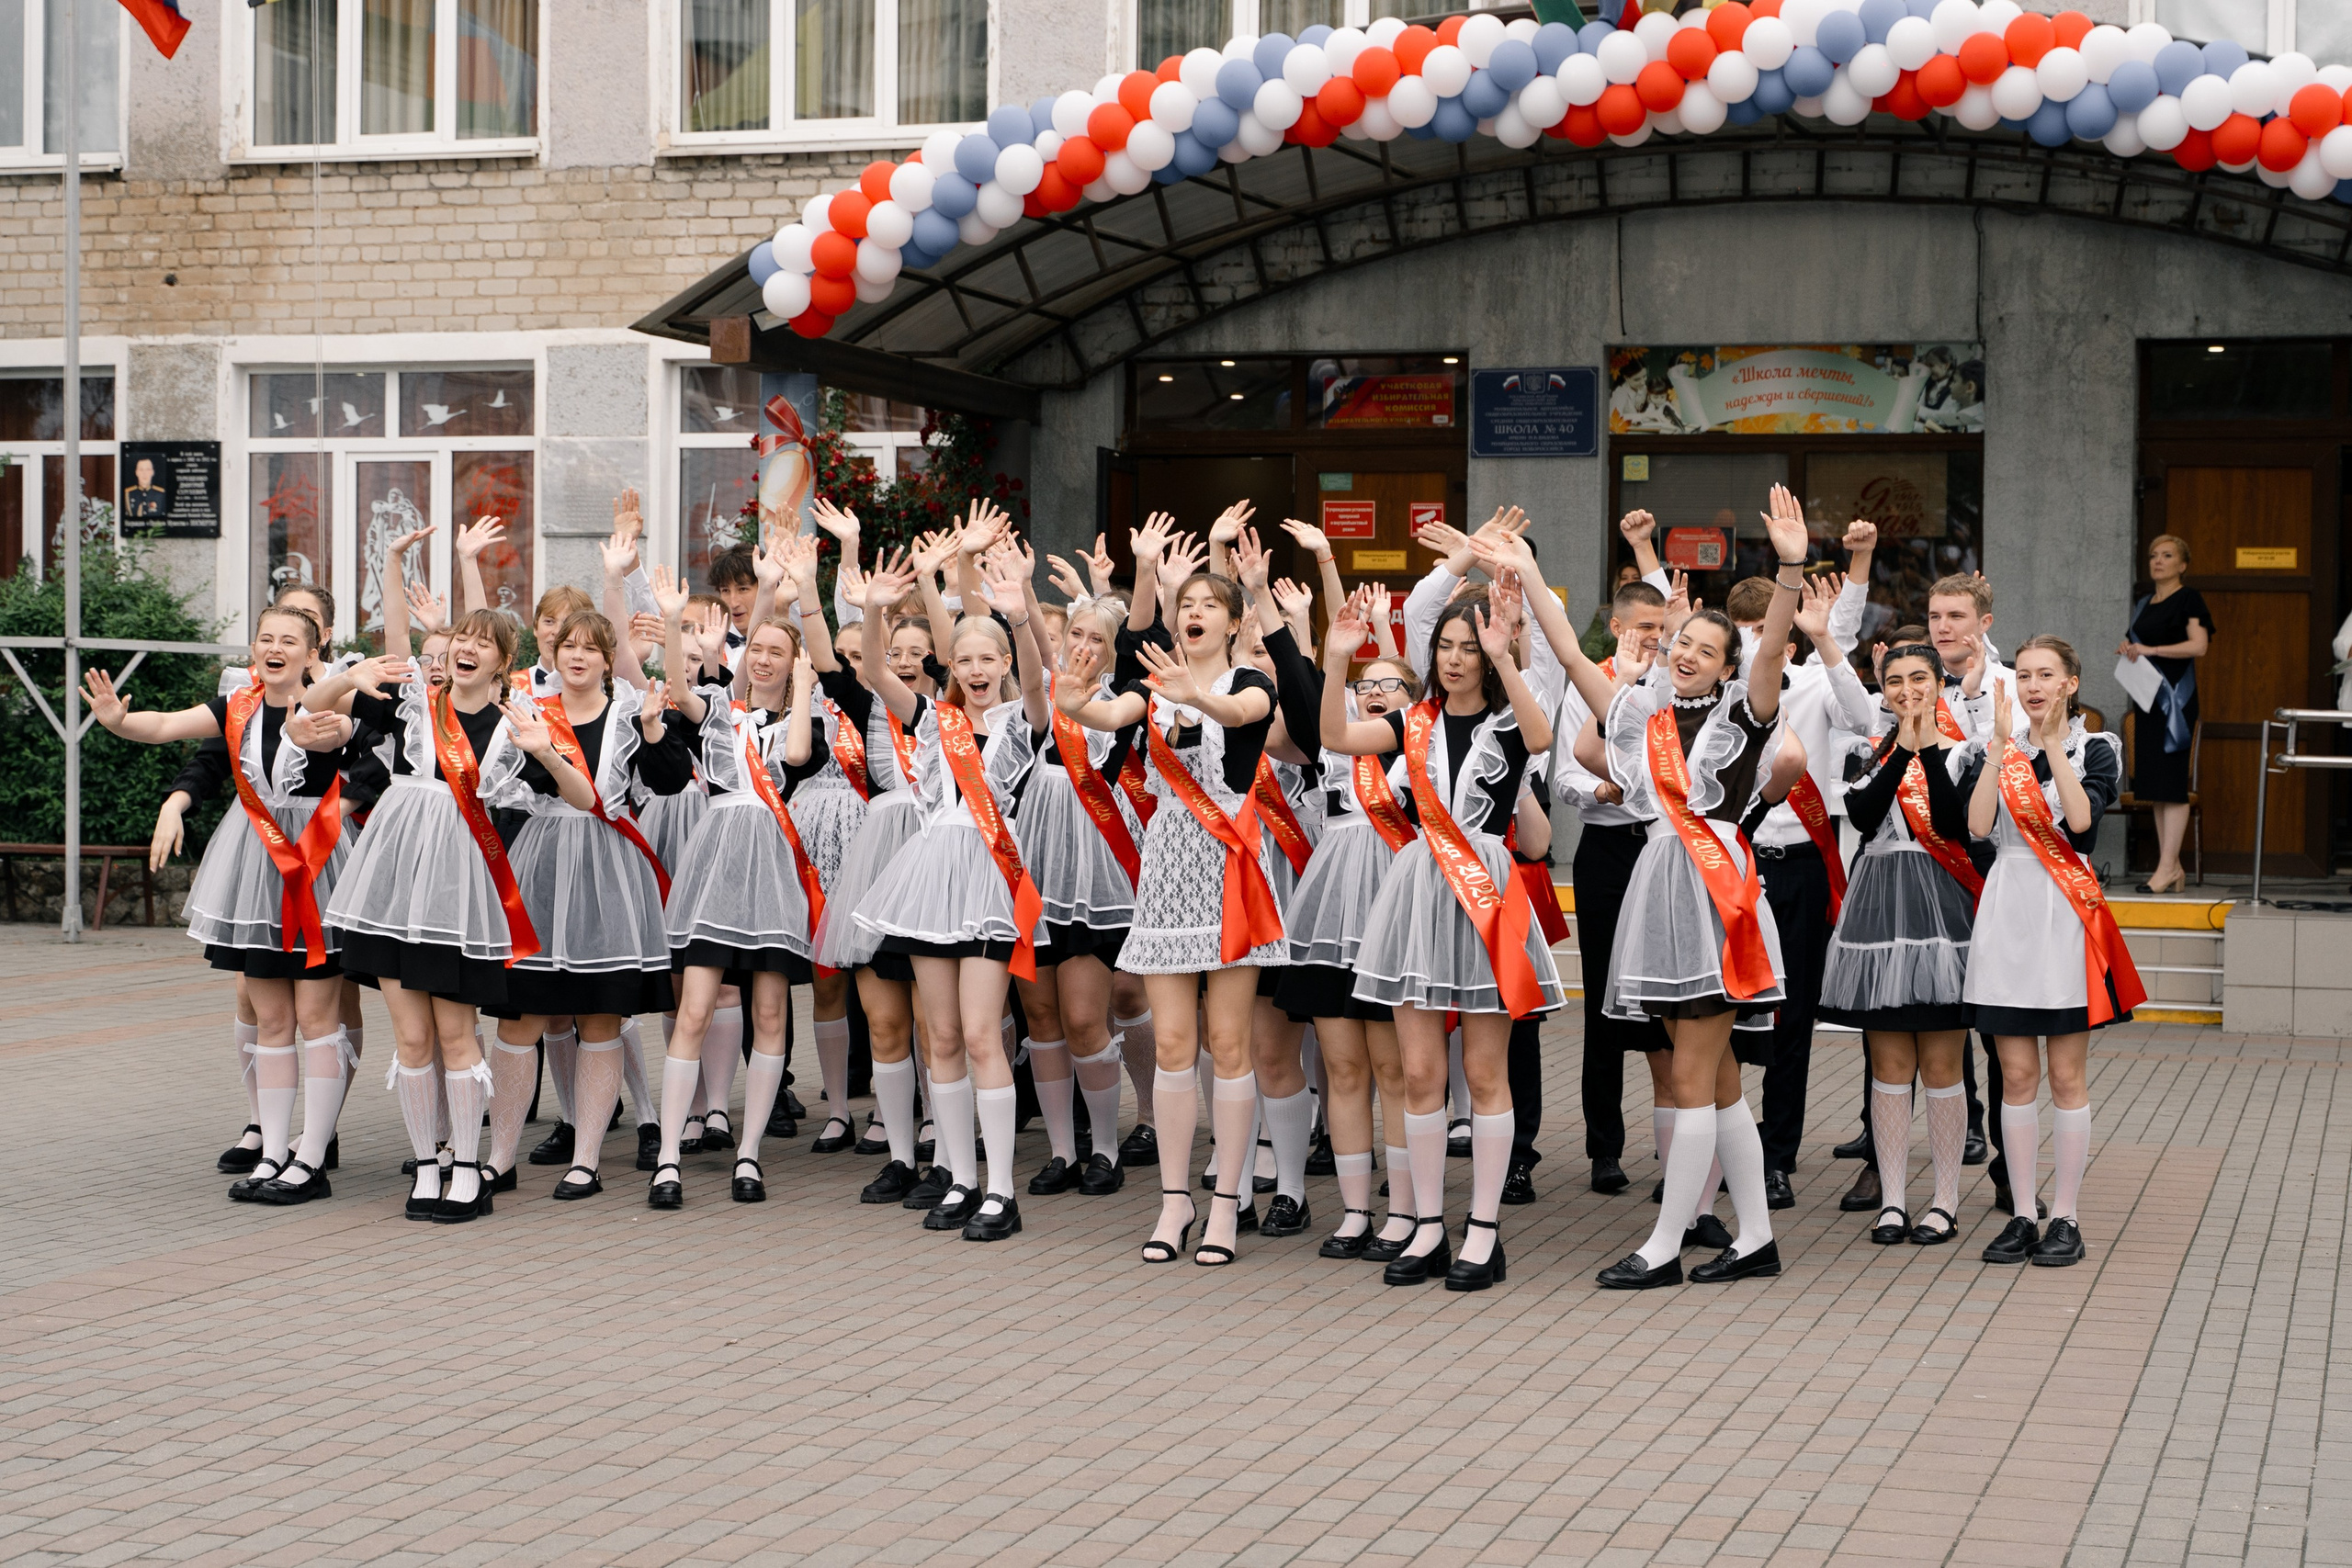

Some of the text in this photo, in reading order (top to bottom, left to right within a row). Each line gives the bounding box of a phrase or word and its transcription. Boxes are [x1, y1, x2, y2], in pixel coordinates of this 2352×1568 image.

[1380, 382, 1442, 390] УЧАСТКОВАЯ
[1732, 366, 1856, 386] «Школа мечты,
[1373, 393, 1449, 401] ИЗБИРАТЕЛЬНАЯ
[1725, 388, 1875, 412] надежды и свершений!»
[1494, 424, 1574, 434] ШКОЛА № 40
[952, 730, 1002, 834] Выпускница
[1260, 761, 1281, 802] Александра
[1670, 747, 1690, 795] Письменная
[1124, 775, 1154, 803] 2026
[1653, 715, 1729, 870] Выпускница 2026
[1086, 793, 1115, 821] 2026
[1800, 796, 1826, 827] 2026
[1409, 748, 1501, 909] Выпускница 2026
[2007, 761, 2067, 863] Выпускница
[2062, 865, 2106, 909] 2026
[481, 829, 501, 862] 2026
